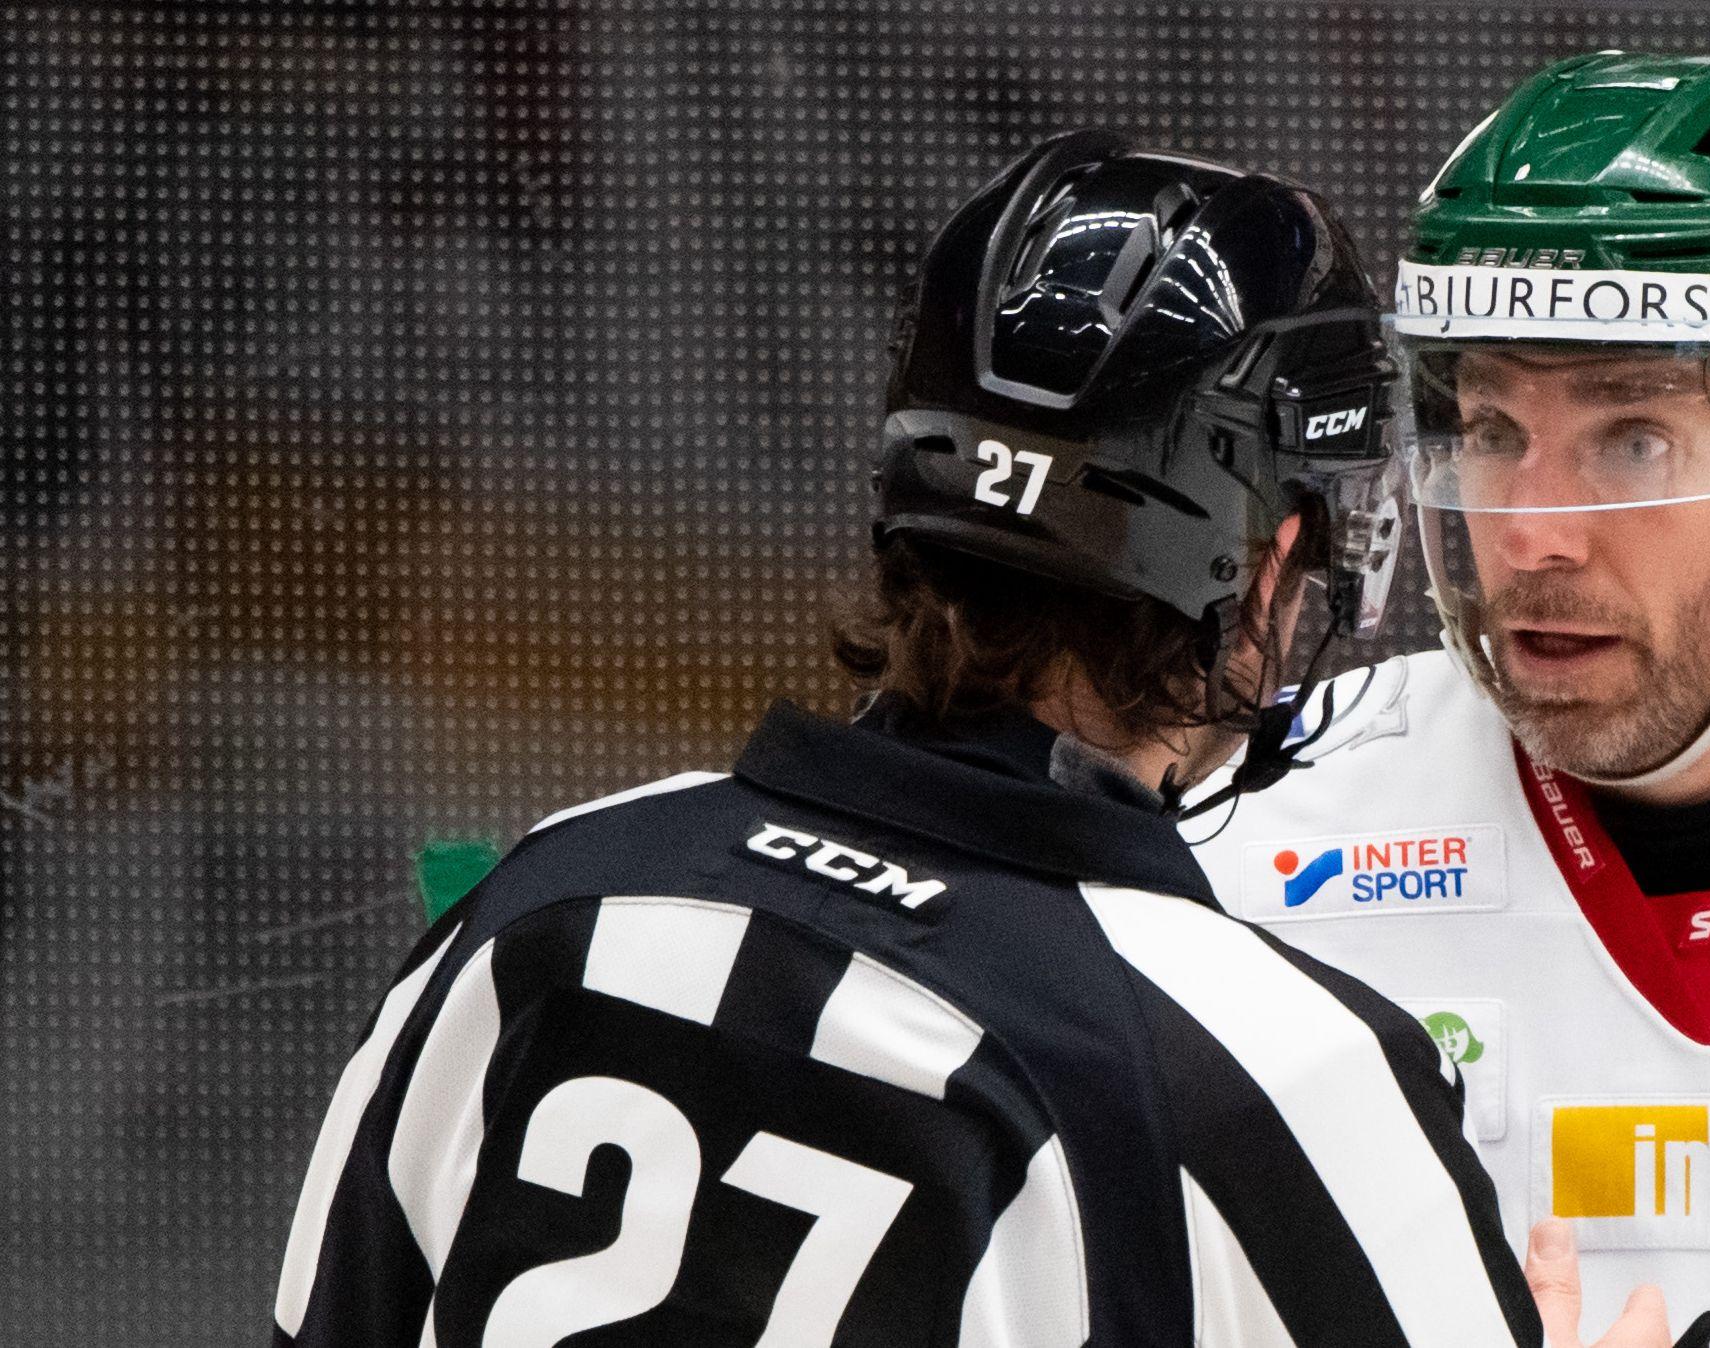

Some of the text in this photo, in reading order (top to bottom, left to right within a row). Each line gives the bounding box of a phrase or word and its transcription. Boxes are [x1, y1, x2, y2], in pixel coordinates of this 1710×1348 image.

[1417, 275, 1708, 334] BJURFORS
[1305, 406, 1367, 440] CCM
[975, 440, 1053, 515] 27
[747, 822, 947, 909] CCM
[1353, 837, 1467, 871] INTER
[1352, 867, 1468, 902] SPORT
[482, 1076, 914, 1348] 27
